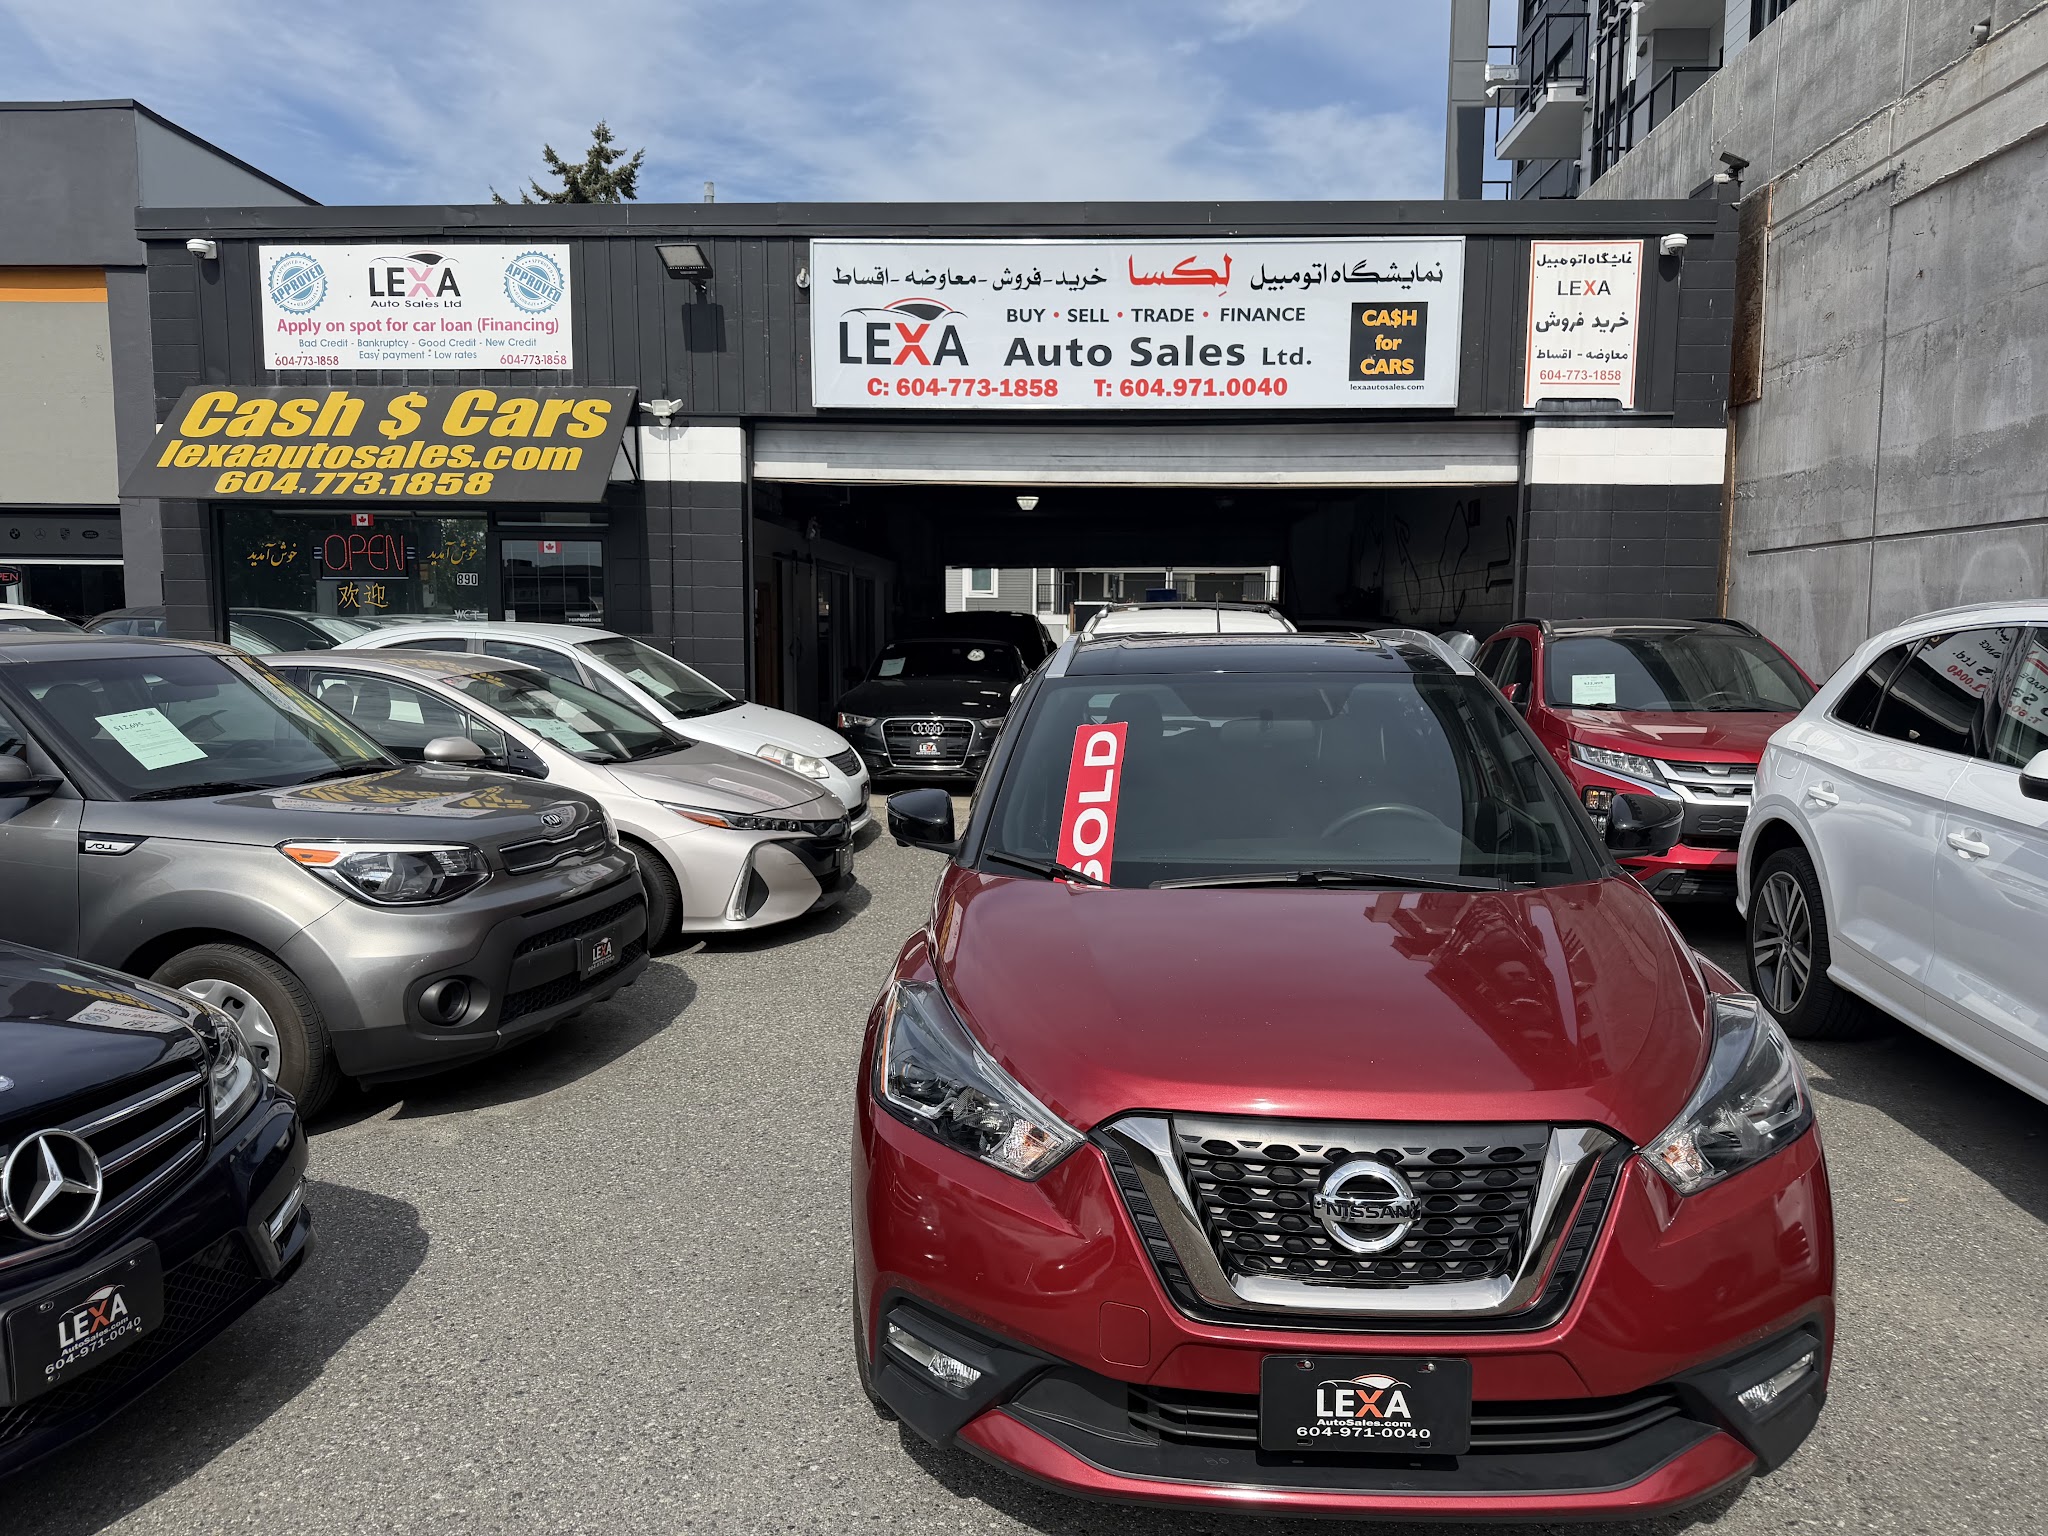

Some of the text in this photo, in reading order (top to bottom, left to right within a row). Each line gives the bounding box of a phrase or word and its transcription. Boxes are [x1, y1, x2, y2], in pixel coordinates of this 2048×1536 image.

[271, 264, 325, 304] APPROVED
[368, 267, 461, 298] LEXA
[505, 263, 562, 302] APPROVED
[1250, 262, 1327, 291] اتومبیل
[1557, 279, 1612, 296] LEXA
[370, 299, 462, 308] Auto Sales Ltd
[1006, 307, 1306, 323] BUY SELL TRADE FINANCE
[1362, 309, 1417, 328] CA$H
[1535, 311, 1629, 333] خرید فروش
[277, 317, 559, 337] Apply on spot for car loan (Financing)
[299, 338, 317, 347] Bad
[320, 338, 348, 347] Credit
[357, 338, 409, 350] Bankruptcy
[418, 338, 445, 347] Good
[448, 338, 476, 347] Credit
[486, 338, 505, 347] New
[508, 338, 537, 347] Credit
[839, 321, 969, 366] LEXA
[1003, 335, 1312, 367] Auto Sales Ltd.
[1374, 333, 1403, 351] for
[275, 354, 339, 366] 604-773-1858
[359, 350, 380, 361] Easy
[382, 350, 425, 361] payment
[434, 350, 450, 359] Low
[453, 350, 477, 359] rates
[500, 353, 567, 366] 604-773-1858
[1536, 349, 1572, 360] اقساط
[1586, 349, 1629, 363] معاوضه
[1360, 357, 1415, 376] CARS
[1539, 369, 1622, 381] 604-773-1858
[867, 377, 1288, 398] C: 604-773-1858 T: 604.971.0040
[1350, 382, 1425, 391] lexaautosales.com
[179, 388, 614, 441] Cash $ Cars
[156, 439, 584, 471] lexaautosales.com
[214, 470, 495, 496] 604.773.1858
[247, 542, 298, 567] خوش آمدید
[324, 534, 404, 571] OPEN
[427, 539, 478, 566] خوش آمدید
[457, 573, 478, 586] 890
[338, 581, 391, 608] 欢迎
[592, 941, 612, 961] LEXA
[1326, 1203, 1410, 1219] NISSAN
[58, 1292, 128, 1349] LEXA
[44, 1316, 142, 1376] 604-971-0040
[61, 1316, 129, 1357] AutoSales.com
[1316, 1388, 1411, 1418] LEXA
[1296, 1426, 1431, 1439] 604-971-0040
[1317, 1419, 1412, 1428] AutoSales.com
